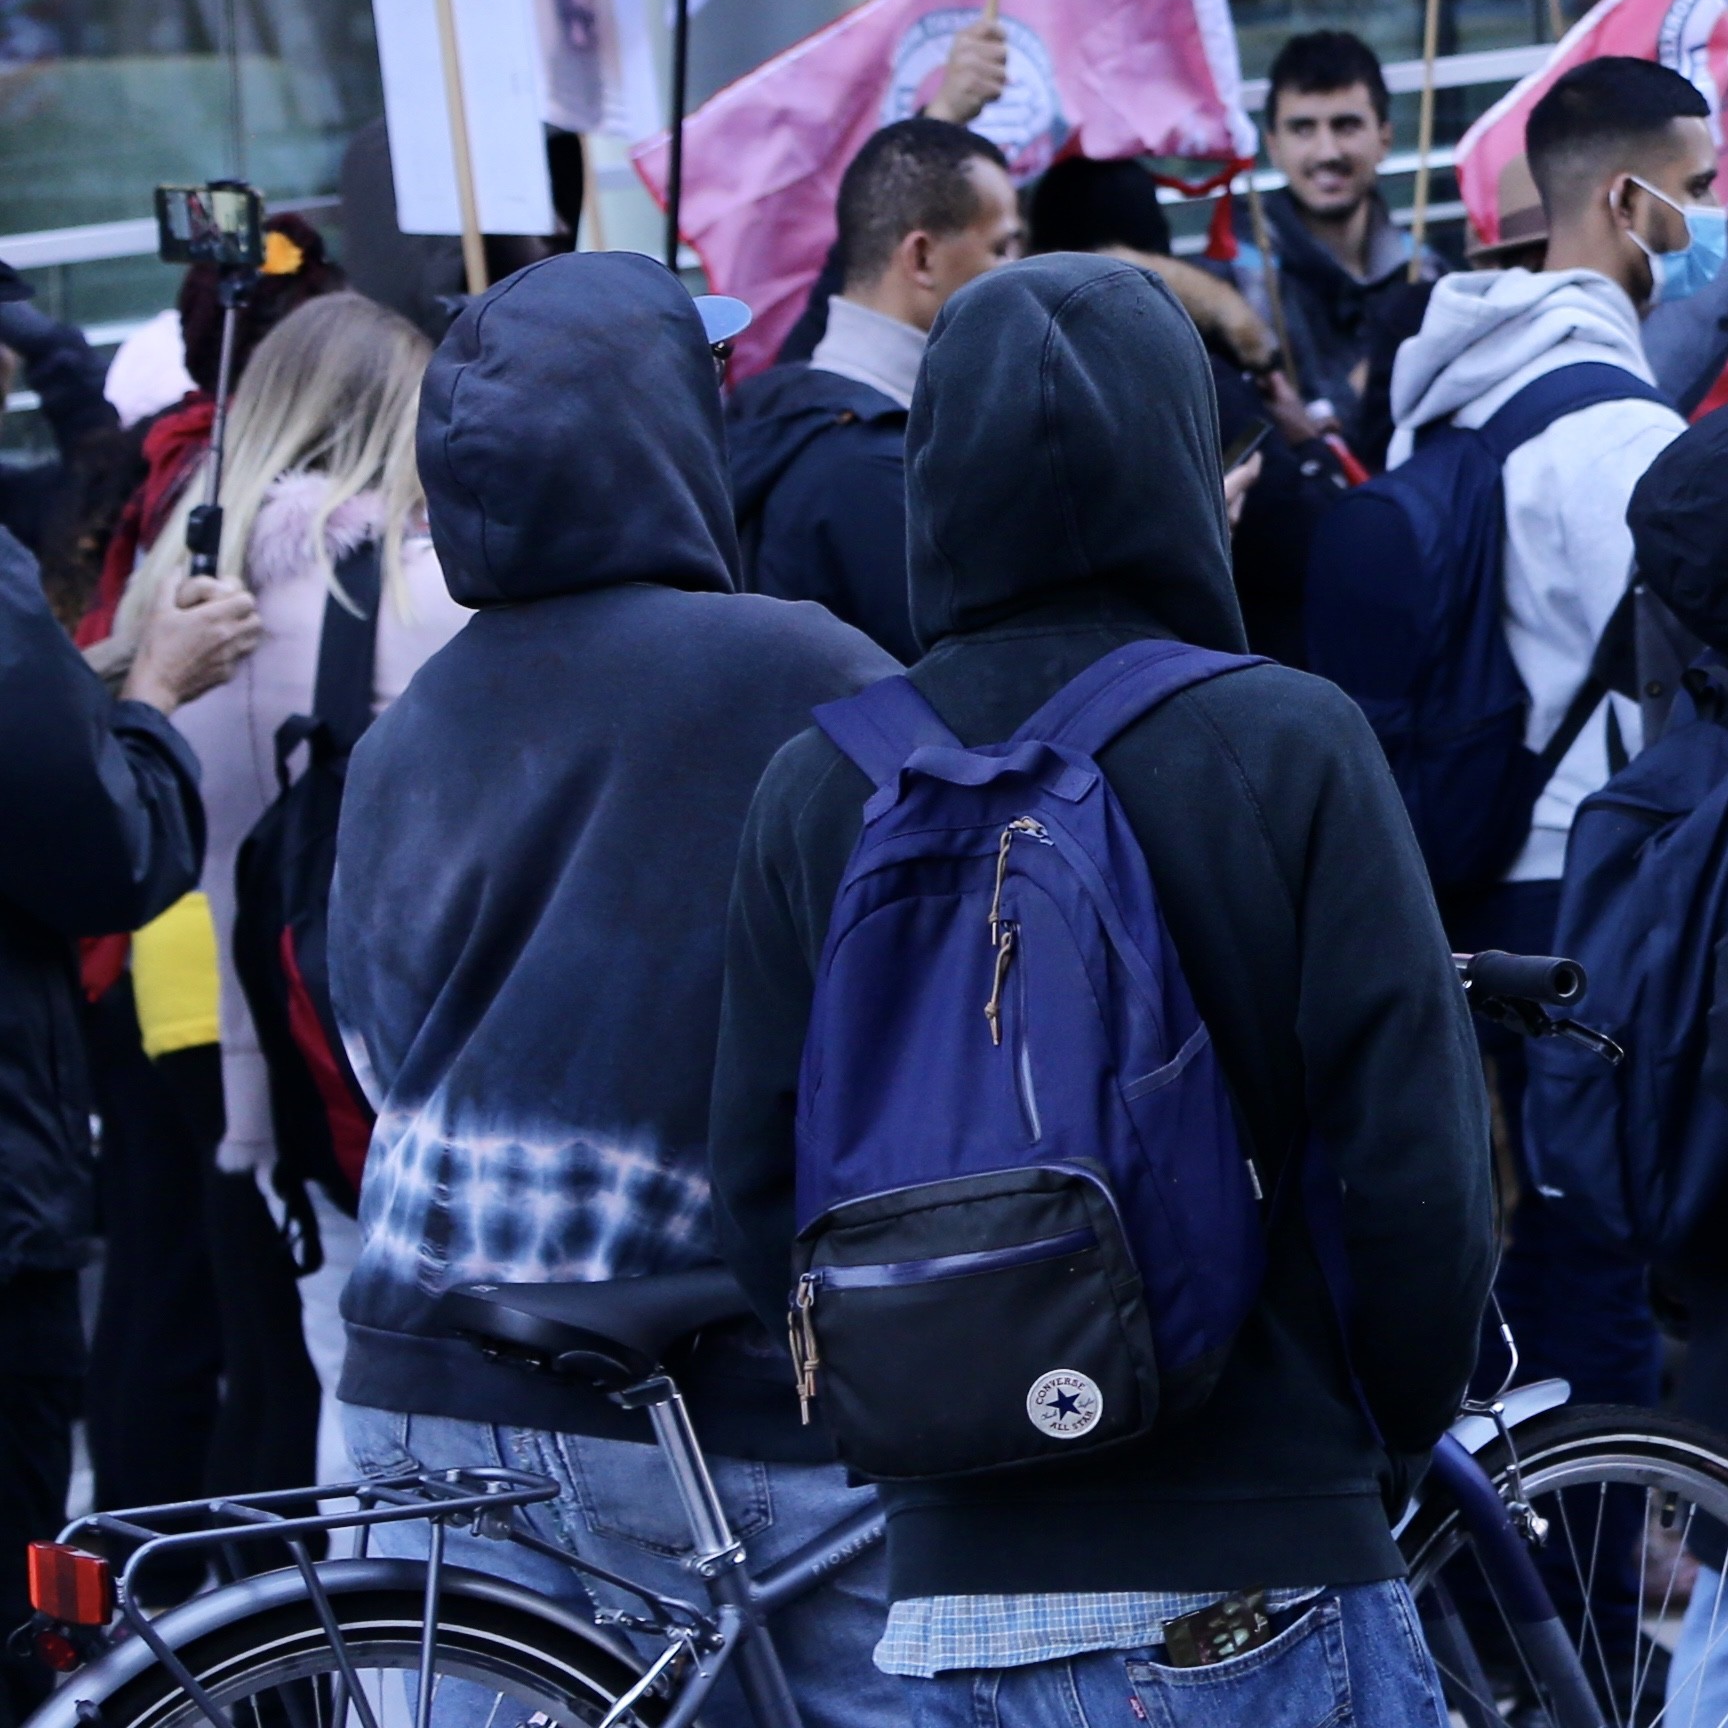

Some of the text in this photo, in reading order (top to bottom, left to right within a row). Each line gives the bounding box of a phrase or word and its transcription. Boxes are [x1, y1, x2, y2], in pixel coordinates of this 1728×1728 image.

[1036, 1377, 1085, 1404] CONVERSE
[1050, 1422, 1069, 1431] ALL
[1072, 1411, 1094, 1429] STAR
[810, 1526, 881, 1576] PIONEER
